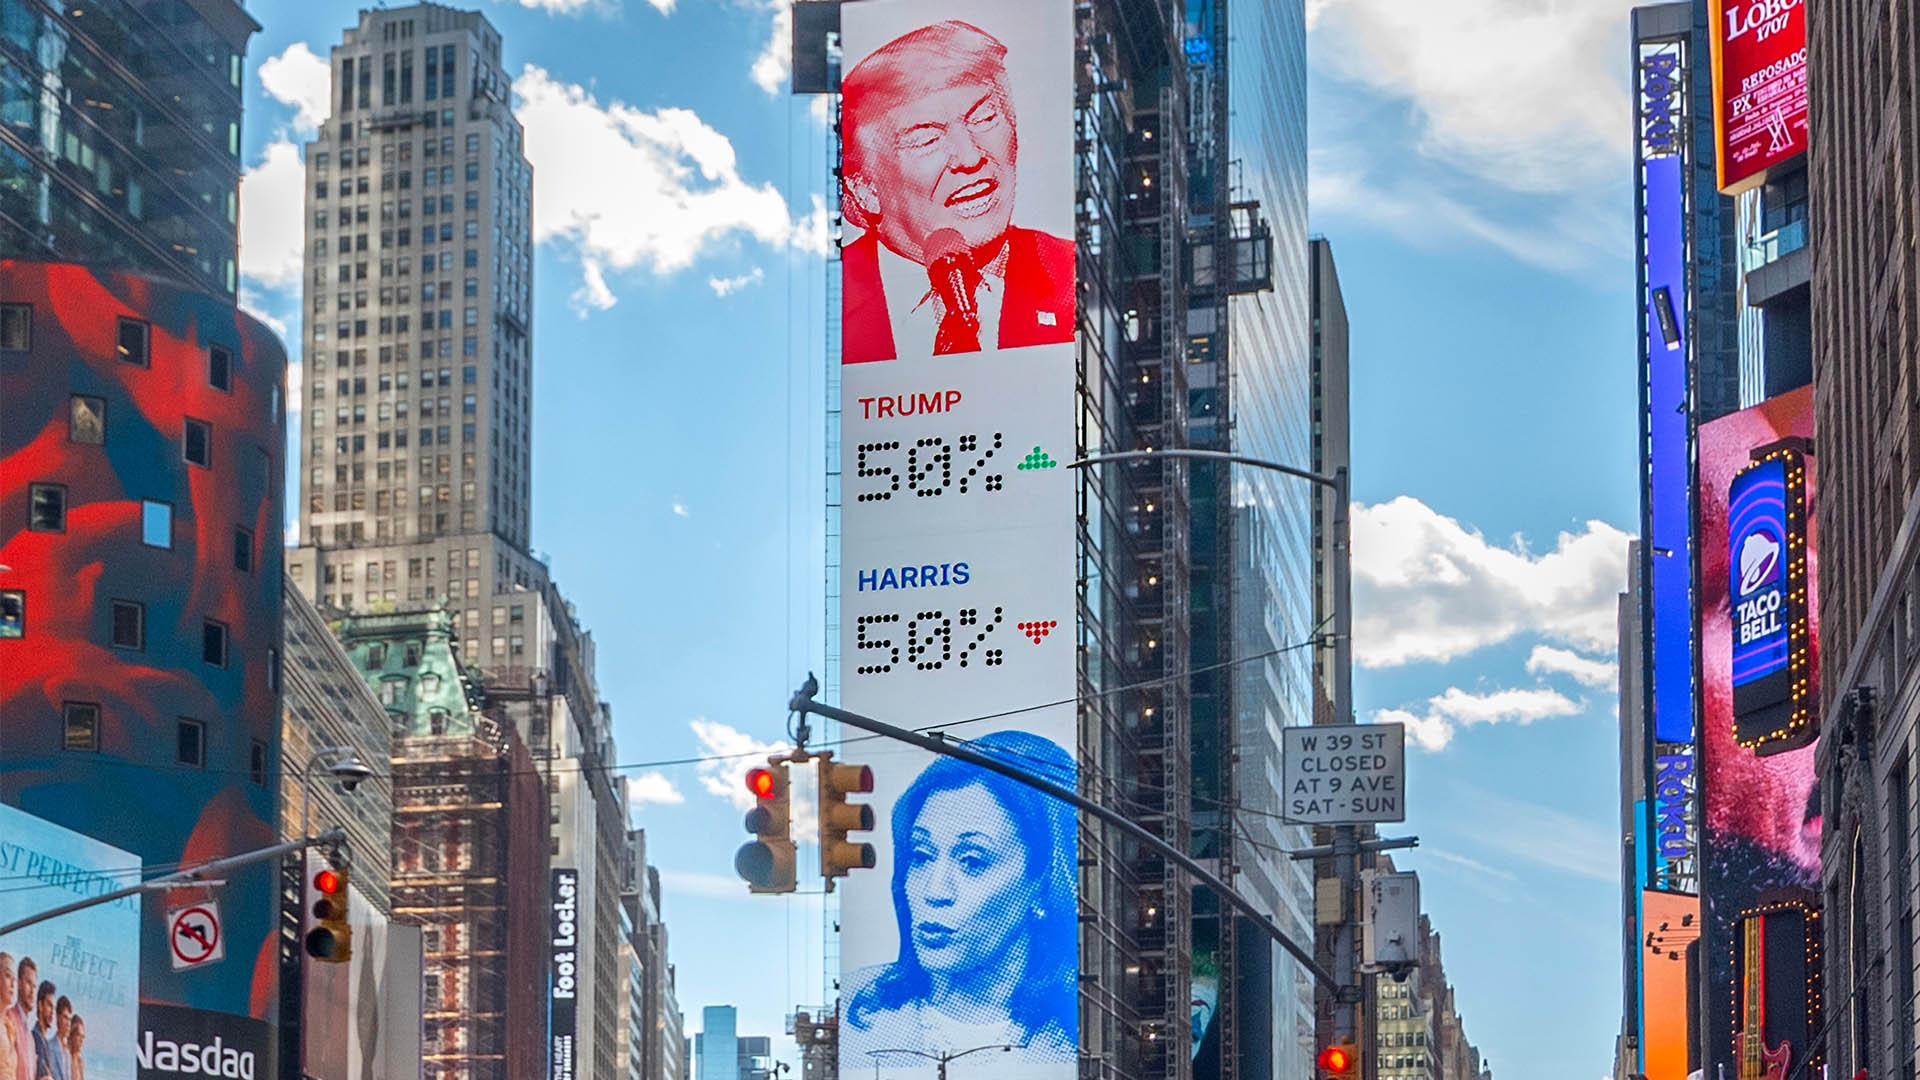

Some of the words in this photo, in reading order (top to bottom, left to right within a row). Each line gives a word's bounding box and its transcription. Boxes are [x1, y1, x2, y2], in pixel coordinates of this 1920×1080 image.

[1757, 11, 1789, 43] 1707
[1733, 93, 1752, 117] PX
[858, 390, 962, 419] TRUMP
[857, 432, 1002, 502] 50%
[858, 562, 970, 591] HARRIS
[1737, 589, 1780, 624] TACO
[857, 606, 1003, 674] 50%
[1741, 612, 1781, 645] BELL
[1301, 736, 1317, 751] W
[1326, 735, 1352, 751] 39
[1361, 733, 1387, 750] ST
[1301, 754, 1386, 773] CLOSED
[1293, 778, 1320, 794] AT
[1329, 777, 1342, 793] 9
[1350, 775, 1395, 793] AVE
[553, 873, 576, 946] Locker
[50, 943, 118, 980] PERFECT
[553, 952, 575, 998] Foot
[136, 1031, 254, 1080] Nasdaq
